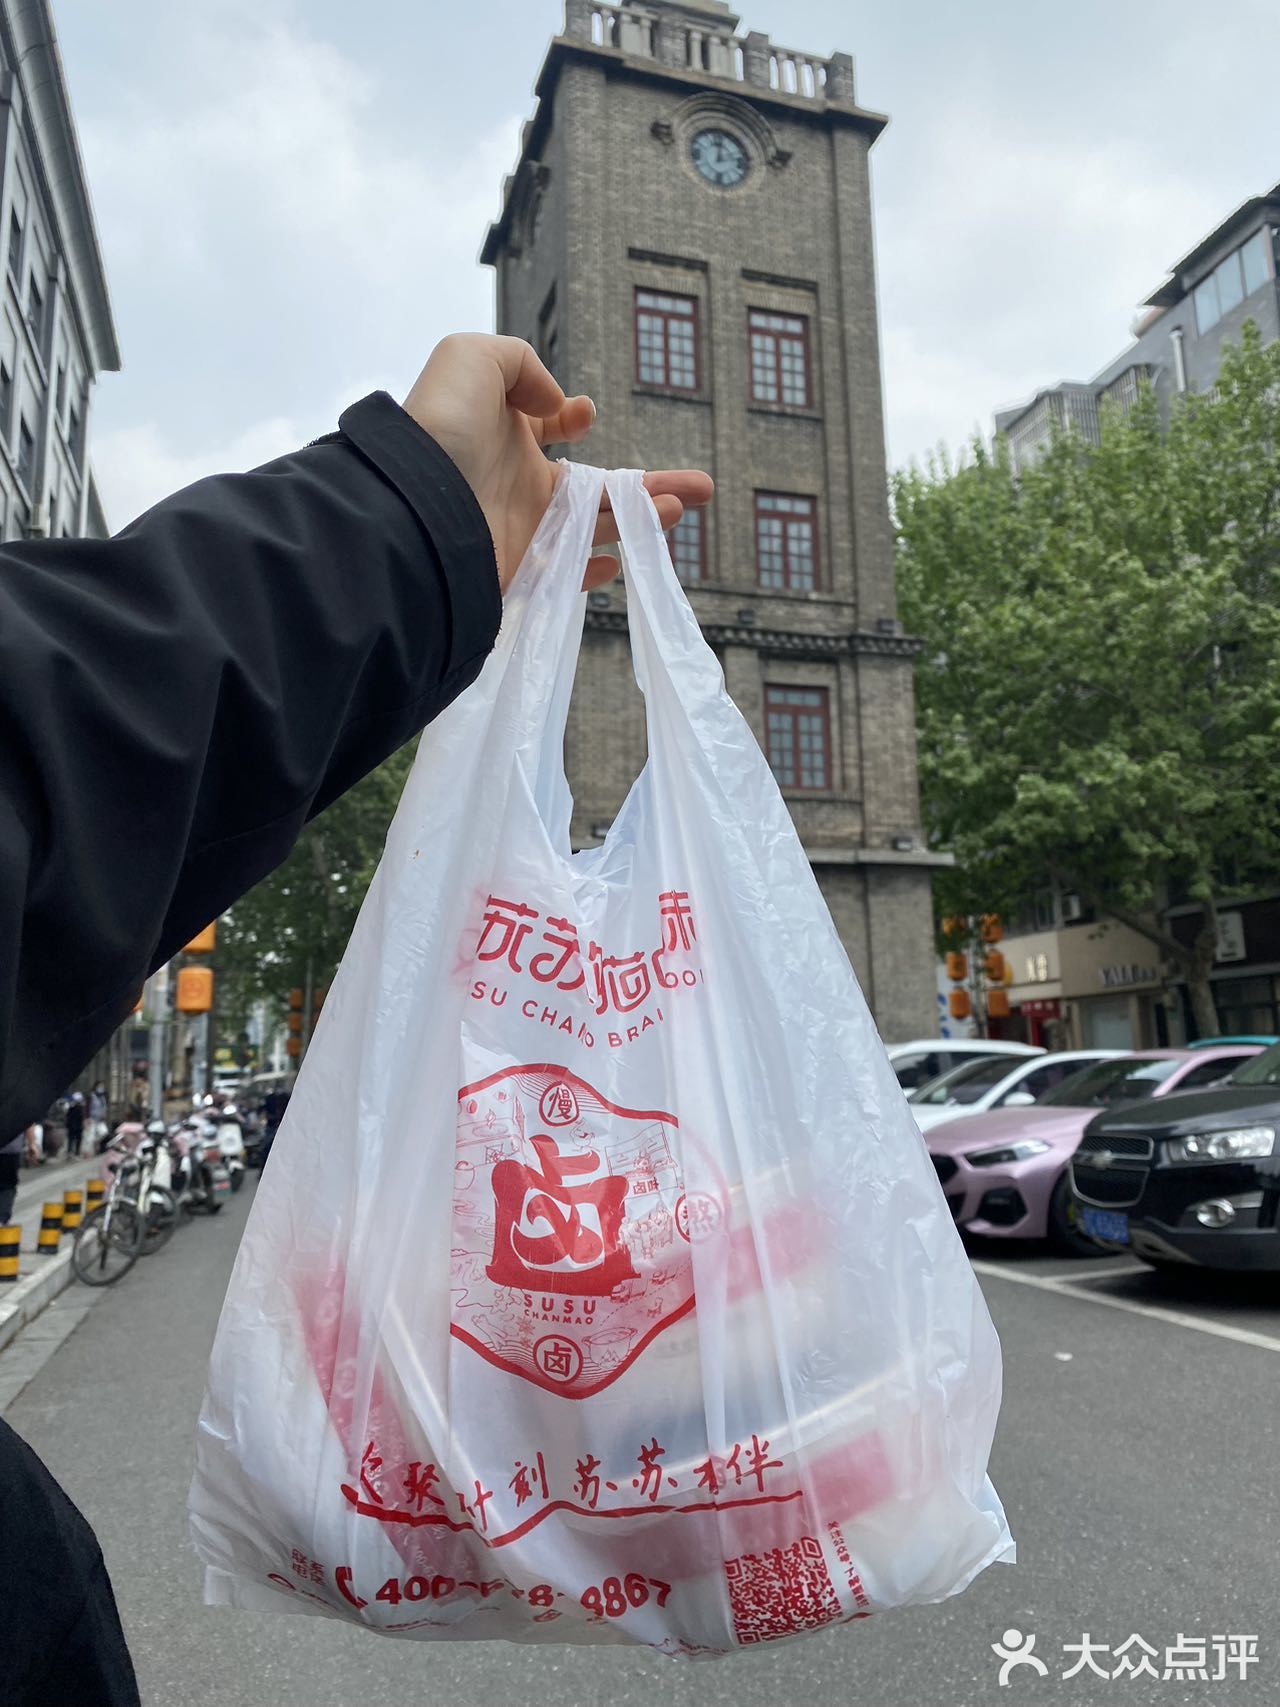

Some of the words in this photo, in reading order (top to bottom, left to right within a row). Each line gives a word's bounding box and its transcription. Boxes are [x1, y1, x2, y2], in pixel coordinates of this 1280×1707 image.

[523, 1294, 597, 1315] SUSU
[523, 1308, 594, 1326] CHANMAO
[543, 1342, 572, 1379] 卤
